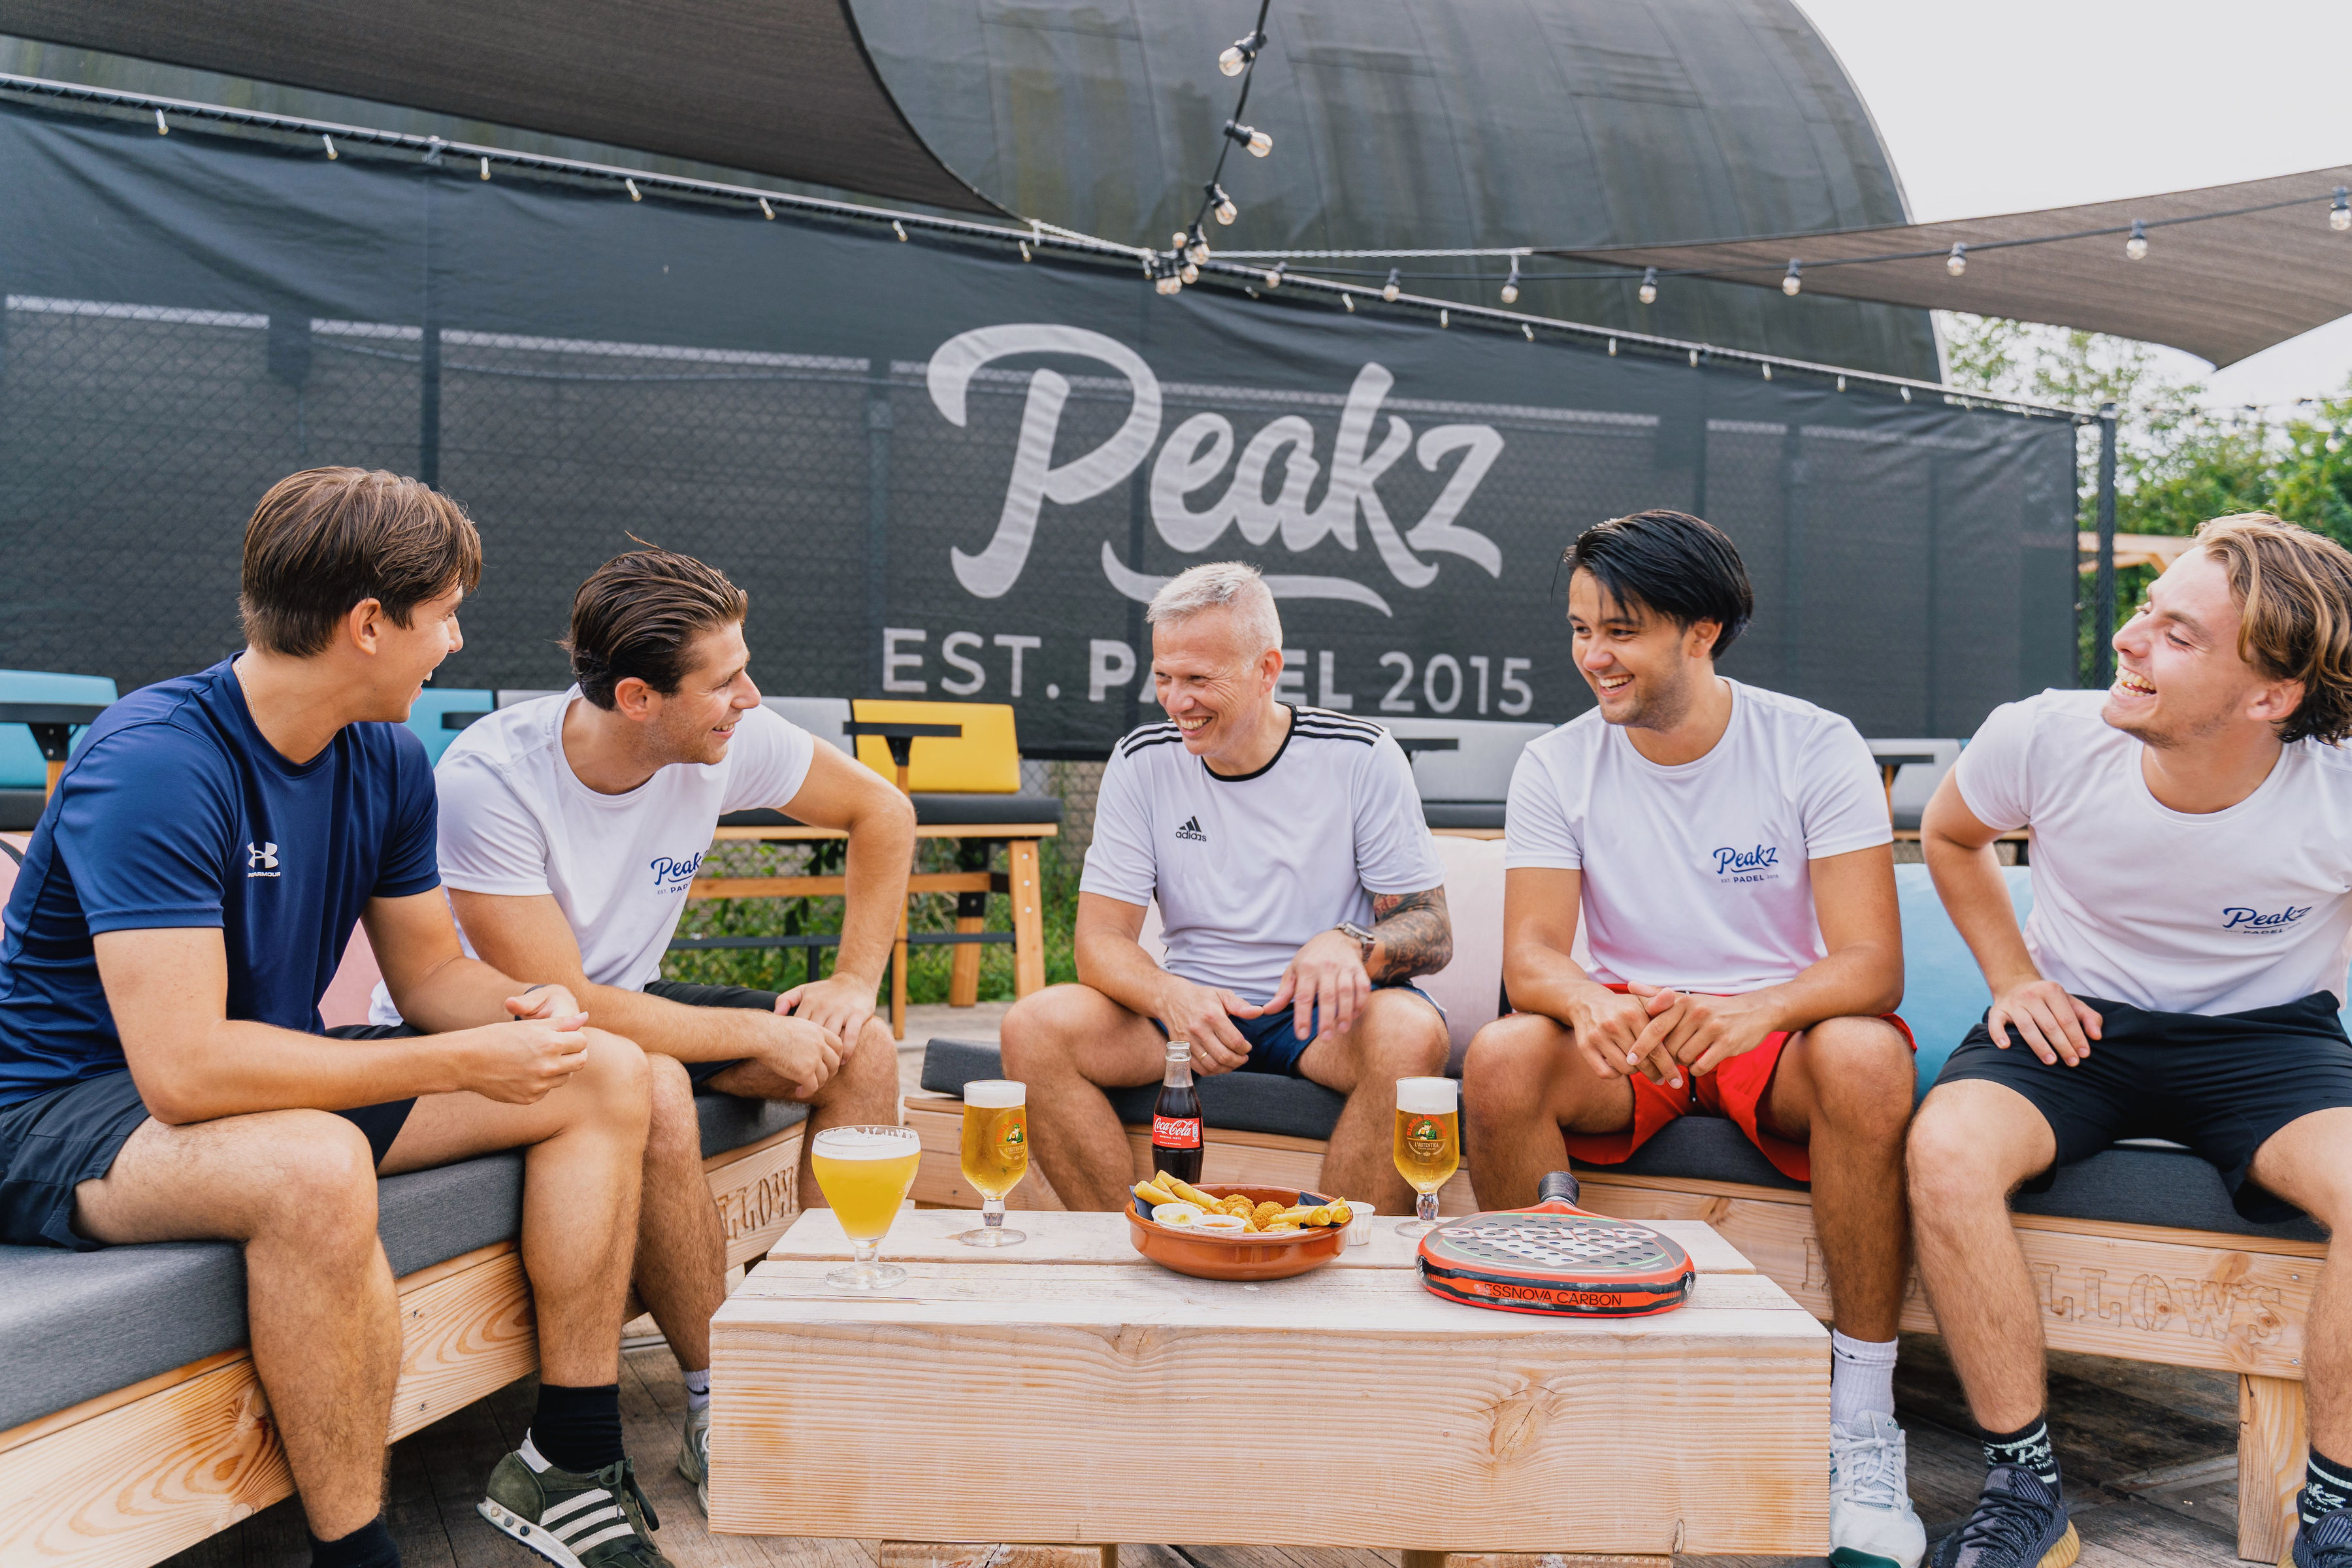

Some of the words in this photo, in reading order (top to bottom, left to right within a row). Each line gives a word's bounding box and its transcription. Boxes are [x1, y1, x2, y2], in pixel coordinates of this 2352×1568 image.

[926, 323, 1505, 600] Peakz
[883, 627, 1060, 699] EST.
[1089, 638, 1353, 710] PEL
[1379, 652, 1533, 716] 2015
[650, 850, 708, 885] Peak
[1713, 844, 1778, 874] Peakz
[670, 880, 691, 894] PAD
[2222, 906, 2313, 928] Peakz
[1154, 1117, 1194, 1136] Coca-Cola
[1556, 1292, 1622, 1306] CARBON
[2033, 1262, 2281, 1346] LLOWS
